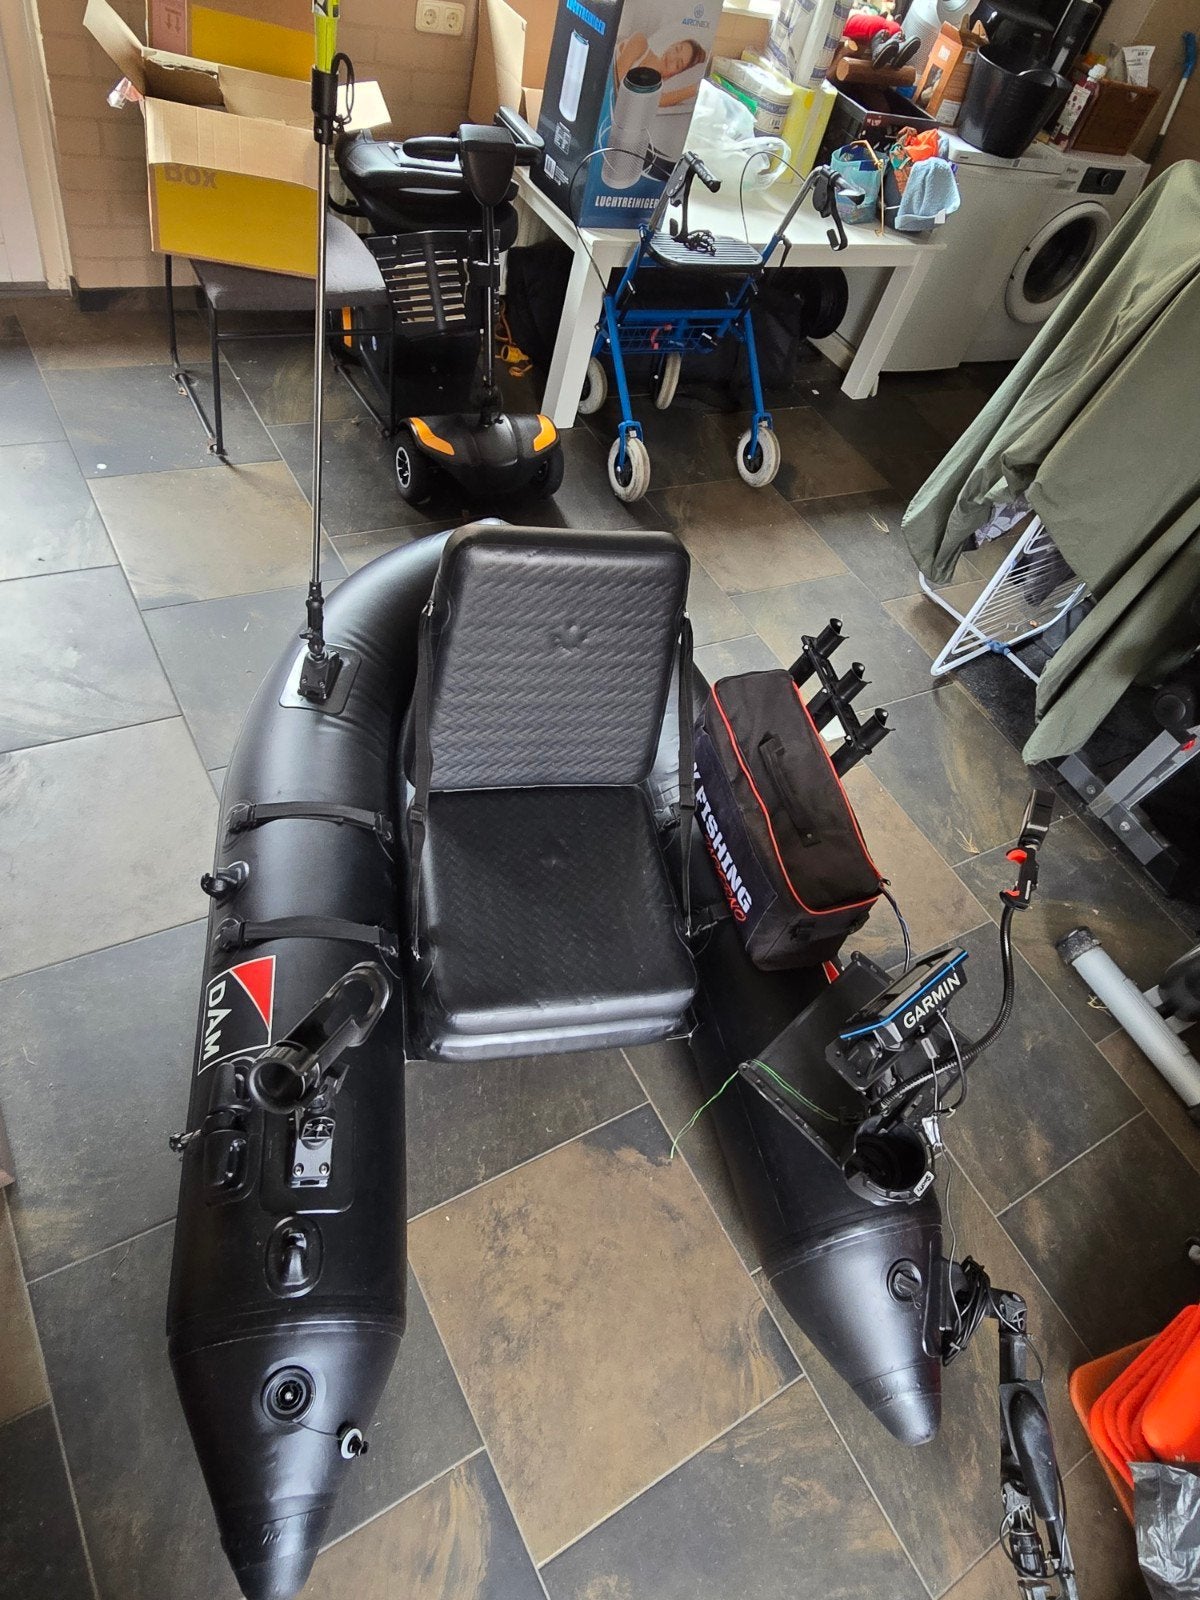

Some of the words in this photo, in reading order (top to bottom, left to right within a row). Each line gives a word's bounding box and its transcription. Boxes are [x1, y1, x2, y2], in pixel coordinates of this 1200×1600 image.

[594, 195, 660, 209] LUCHTREINIGER
[695, 785, 753, 914] FISHING
[203, 980, 232, 1061] DAM
[903, 972, 961, 1029] GARMIN
